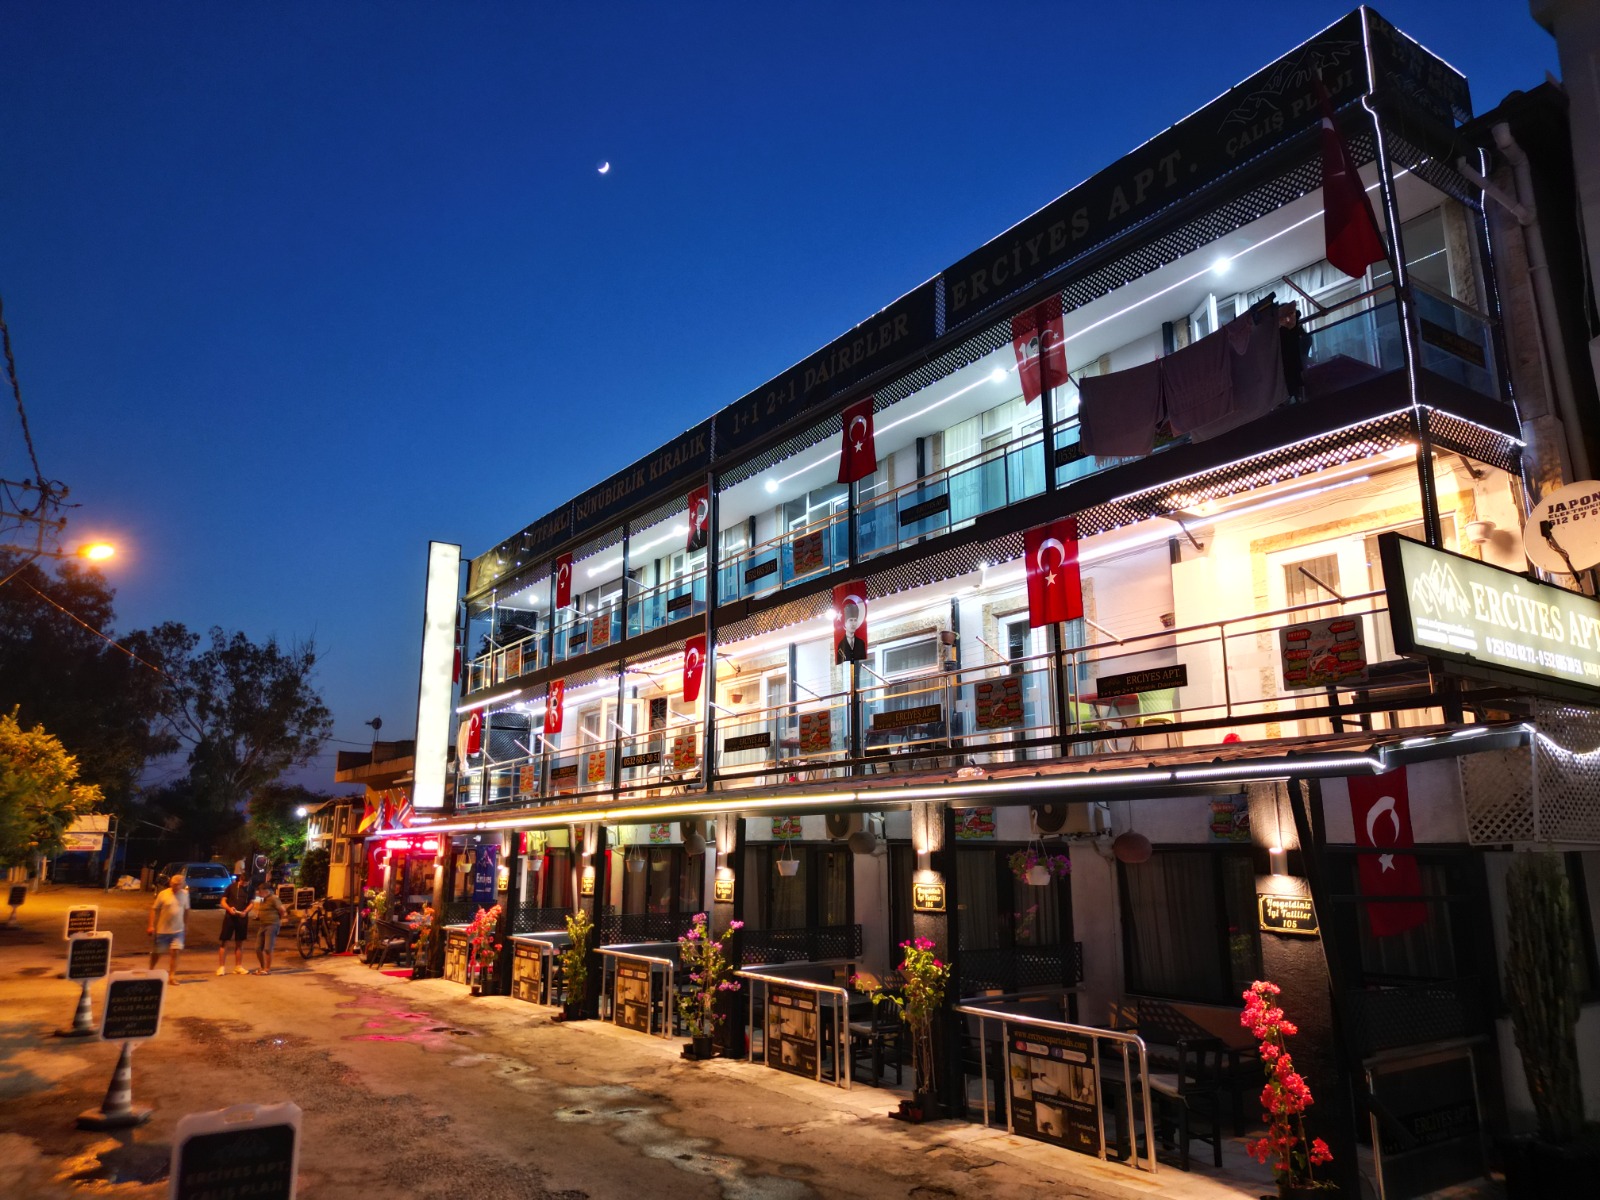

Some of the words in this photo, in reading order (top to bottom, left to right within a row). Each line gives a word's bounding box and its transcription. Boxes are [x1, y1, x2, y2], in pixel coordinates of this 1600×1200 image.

[1225, 111, 1285, 158] ÇALIŞ
[951, 206, 1091, 312] ERCİYES
[1107, 150, 1198, 222] APT.
[732, 401, 760, 436] 1+1
[766, 378, 796, 416] 2+1
[803, 312, 910, 394] DAİRELER
[576, 466, 646, 522] GÜNÜBİRLİK
[649, 432, 706, 482] KİRALIK
[1548, 491, 1600, 514] JAPON
[1572, 511, 1587, 521] 67
[1469, 581, 1565, 643] ERCİYES
[1485, 636, 1492, 654] 0
[1126, 672, 1161, 685] ERCİYES
[1282, 919, 1298, 928] 105
